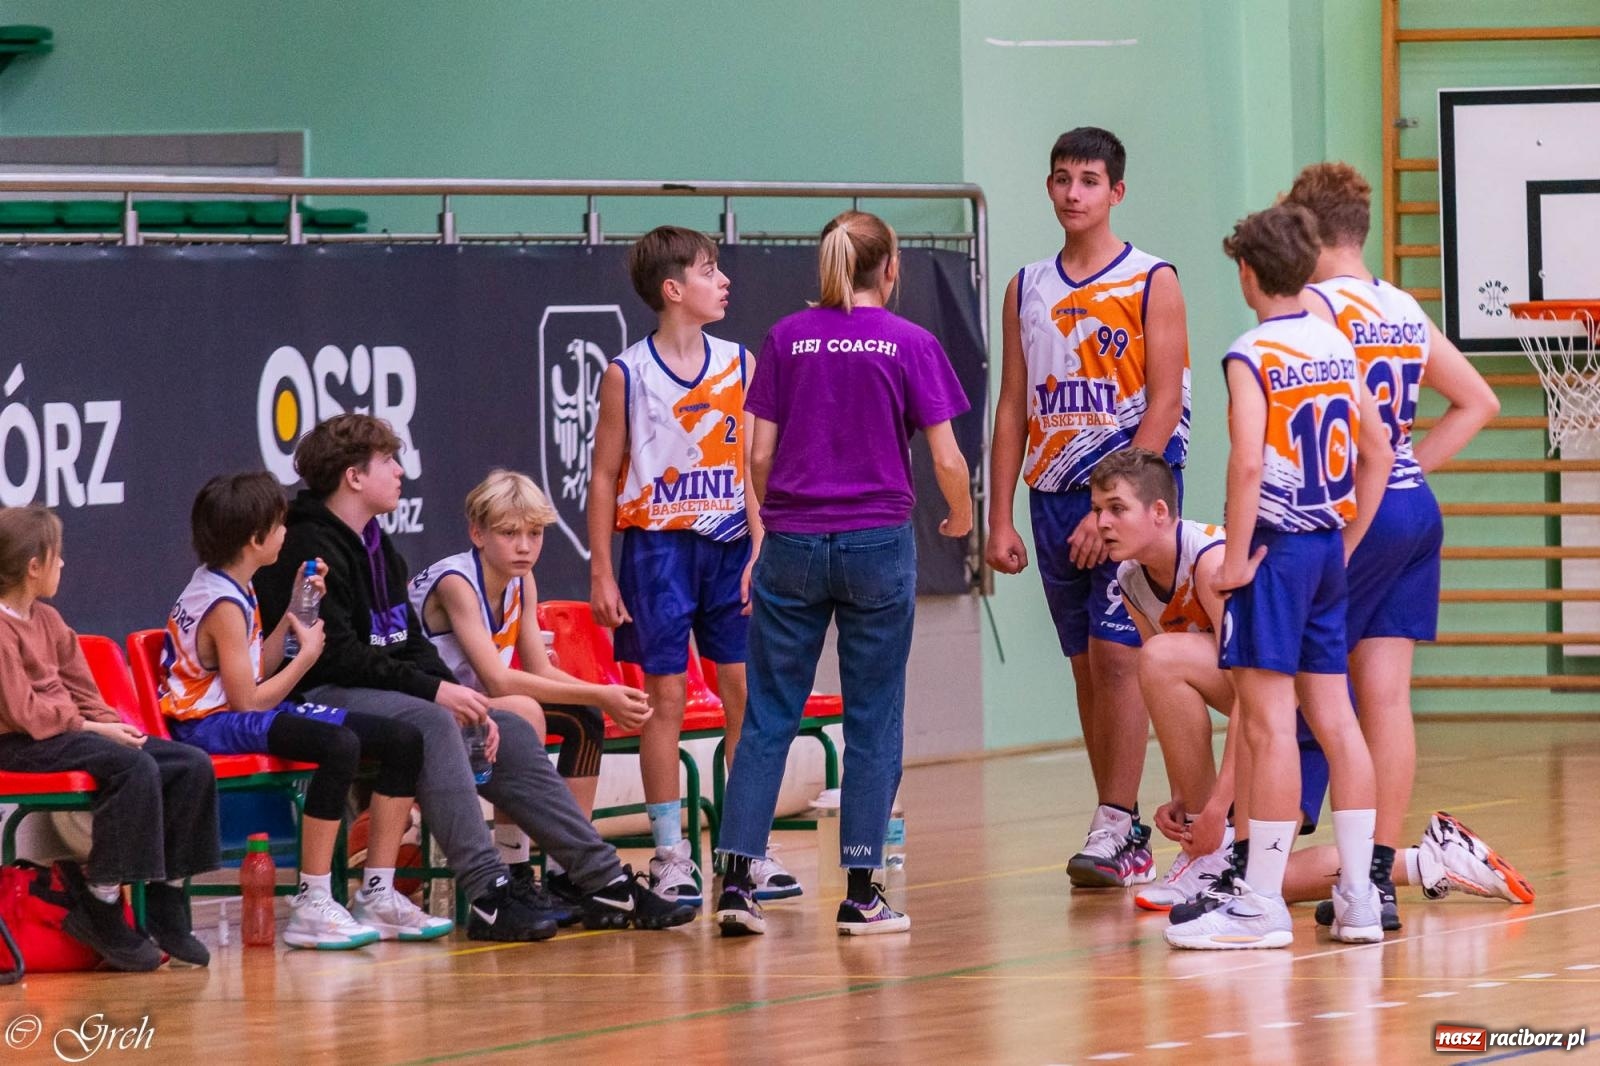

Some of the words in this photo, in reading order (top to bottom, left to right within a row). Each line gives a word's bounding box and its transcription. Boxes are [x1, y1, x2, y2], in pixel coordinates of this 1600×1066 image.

[792, 339, 821, 355] HEJ
[827, 339, 897, 357] COACH!
[1097, 326, 1128, 358] 99
[1036, 380, 1117, 415] MINI
[724, 415, 737, 443] 2
[1290, 397, 1355, 507] 10
[653, 469, 734, 504] MINI
[652, 499, 734, 515] BASKETBALL
[1101, 621, 1136, 631] regio
